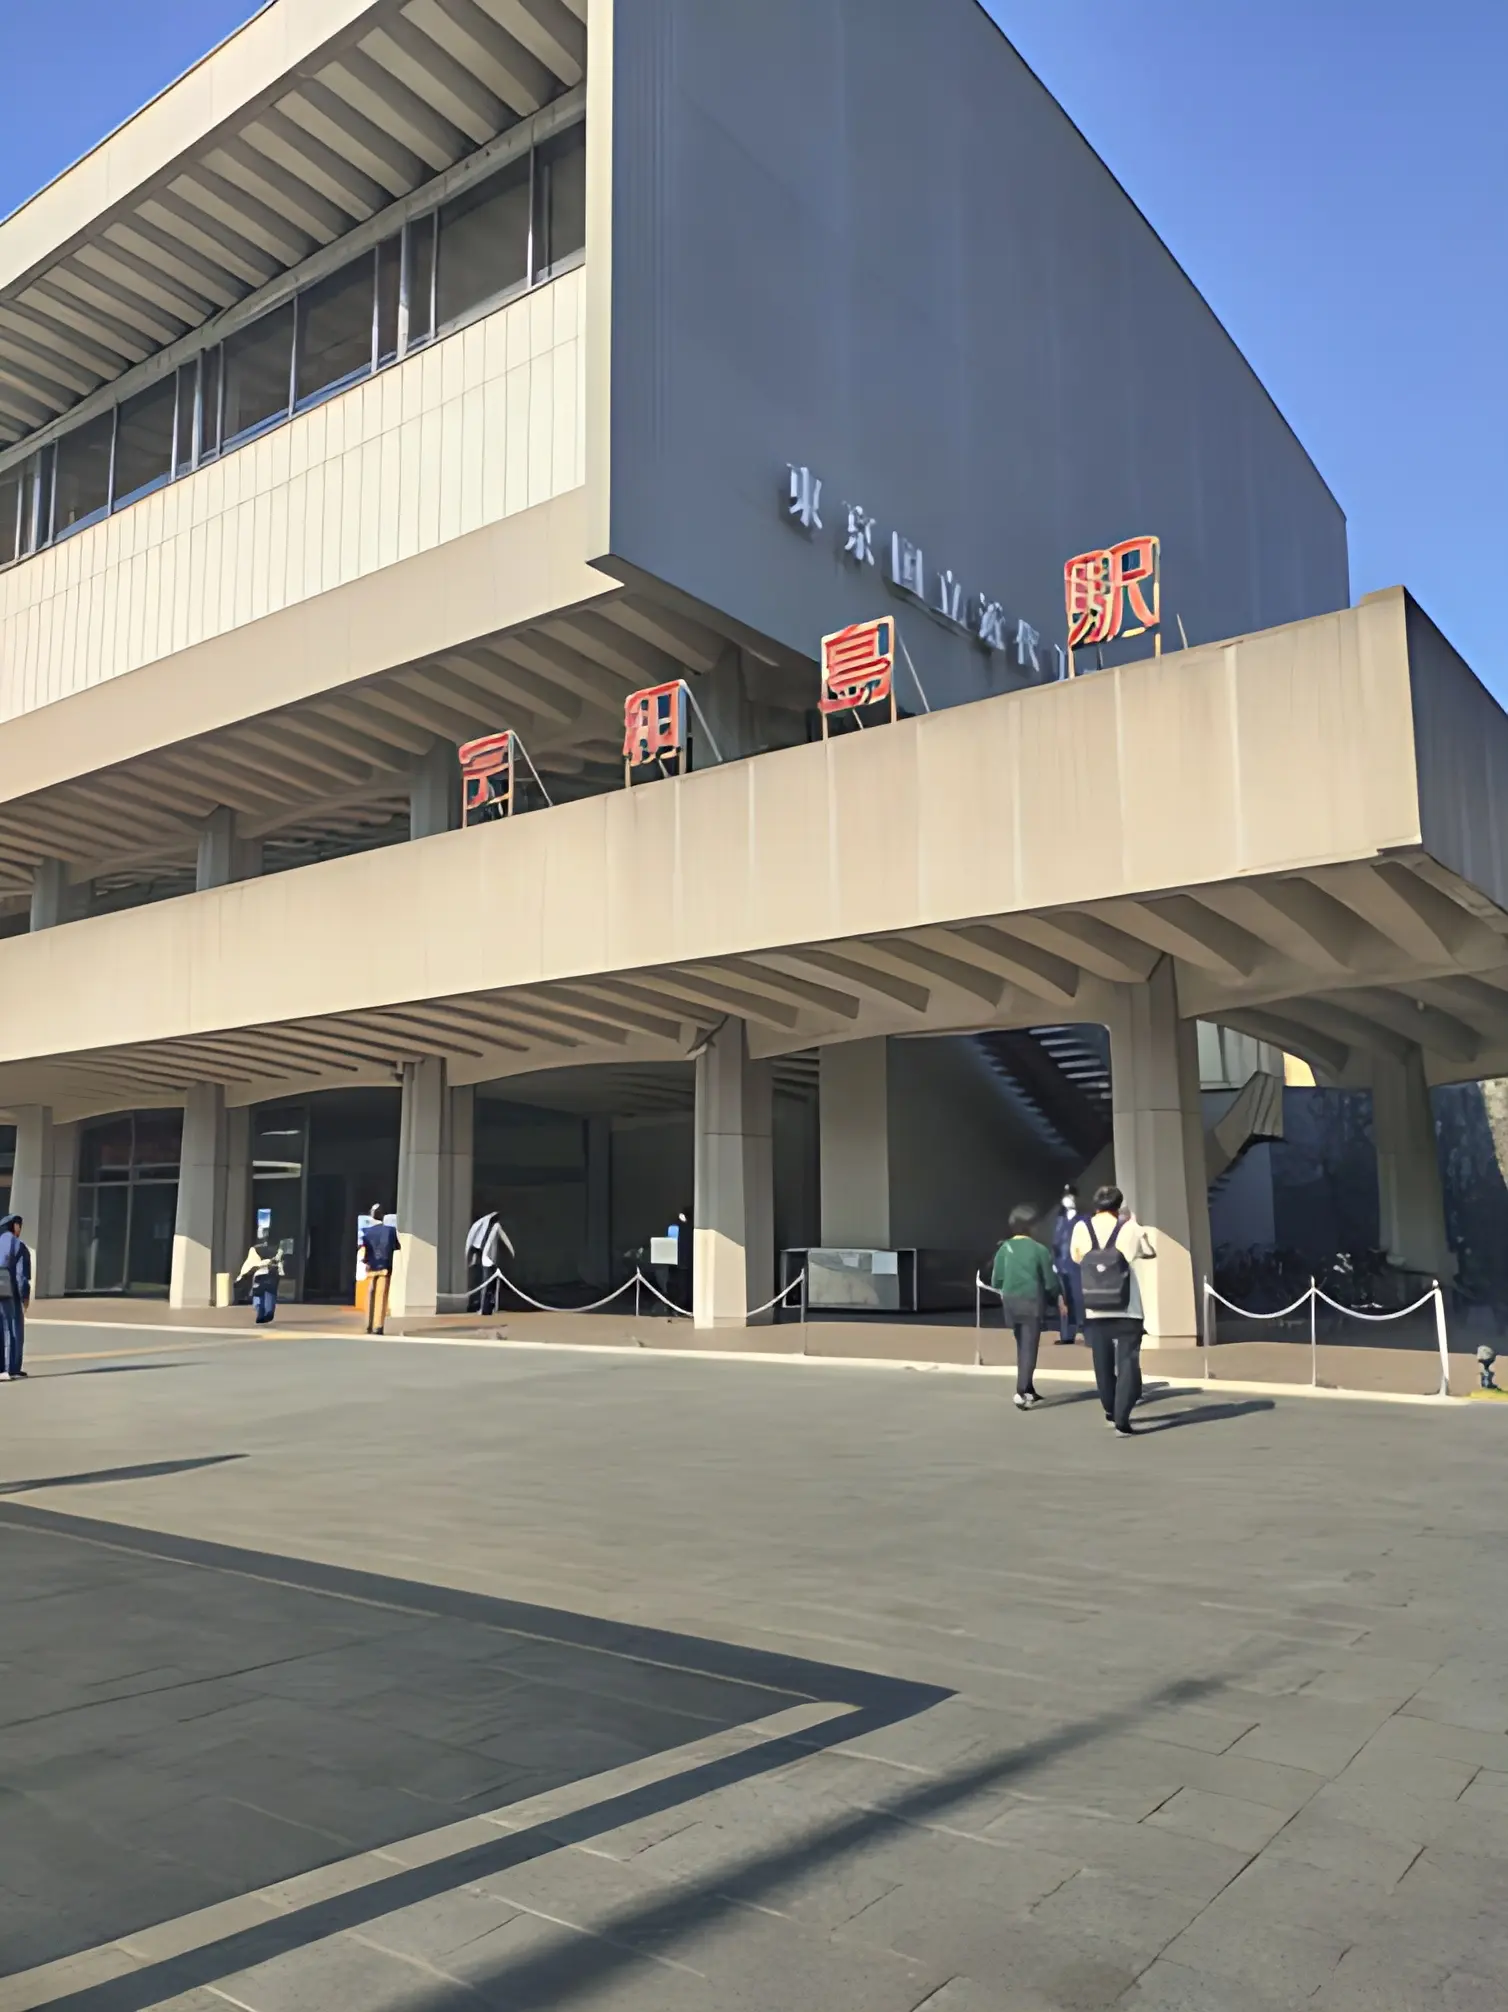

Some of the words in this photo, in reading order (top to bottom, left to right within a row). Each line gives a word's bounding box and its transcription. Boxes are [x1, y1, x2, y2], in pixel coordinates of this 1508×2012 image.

[786, 462, 1067, 681] 東京国立近代
